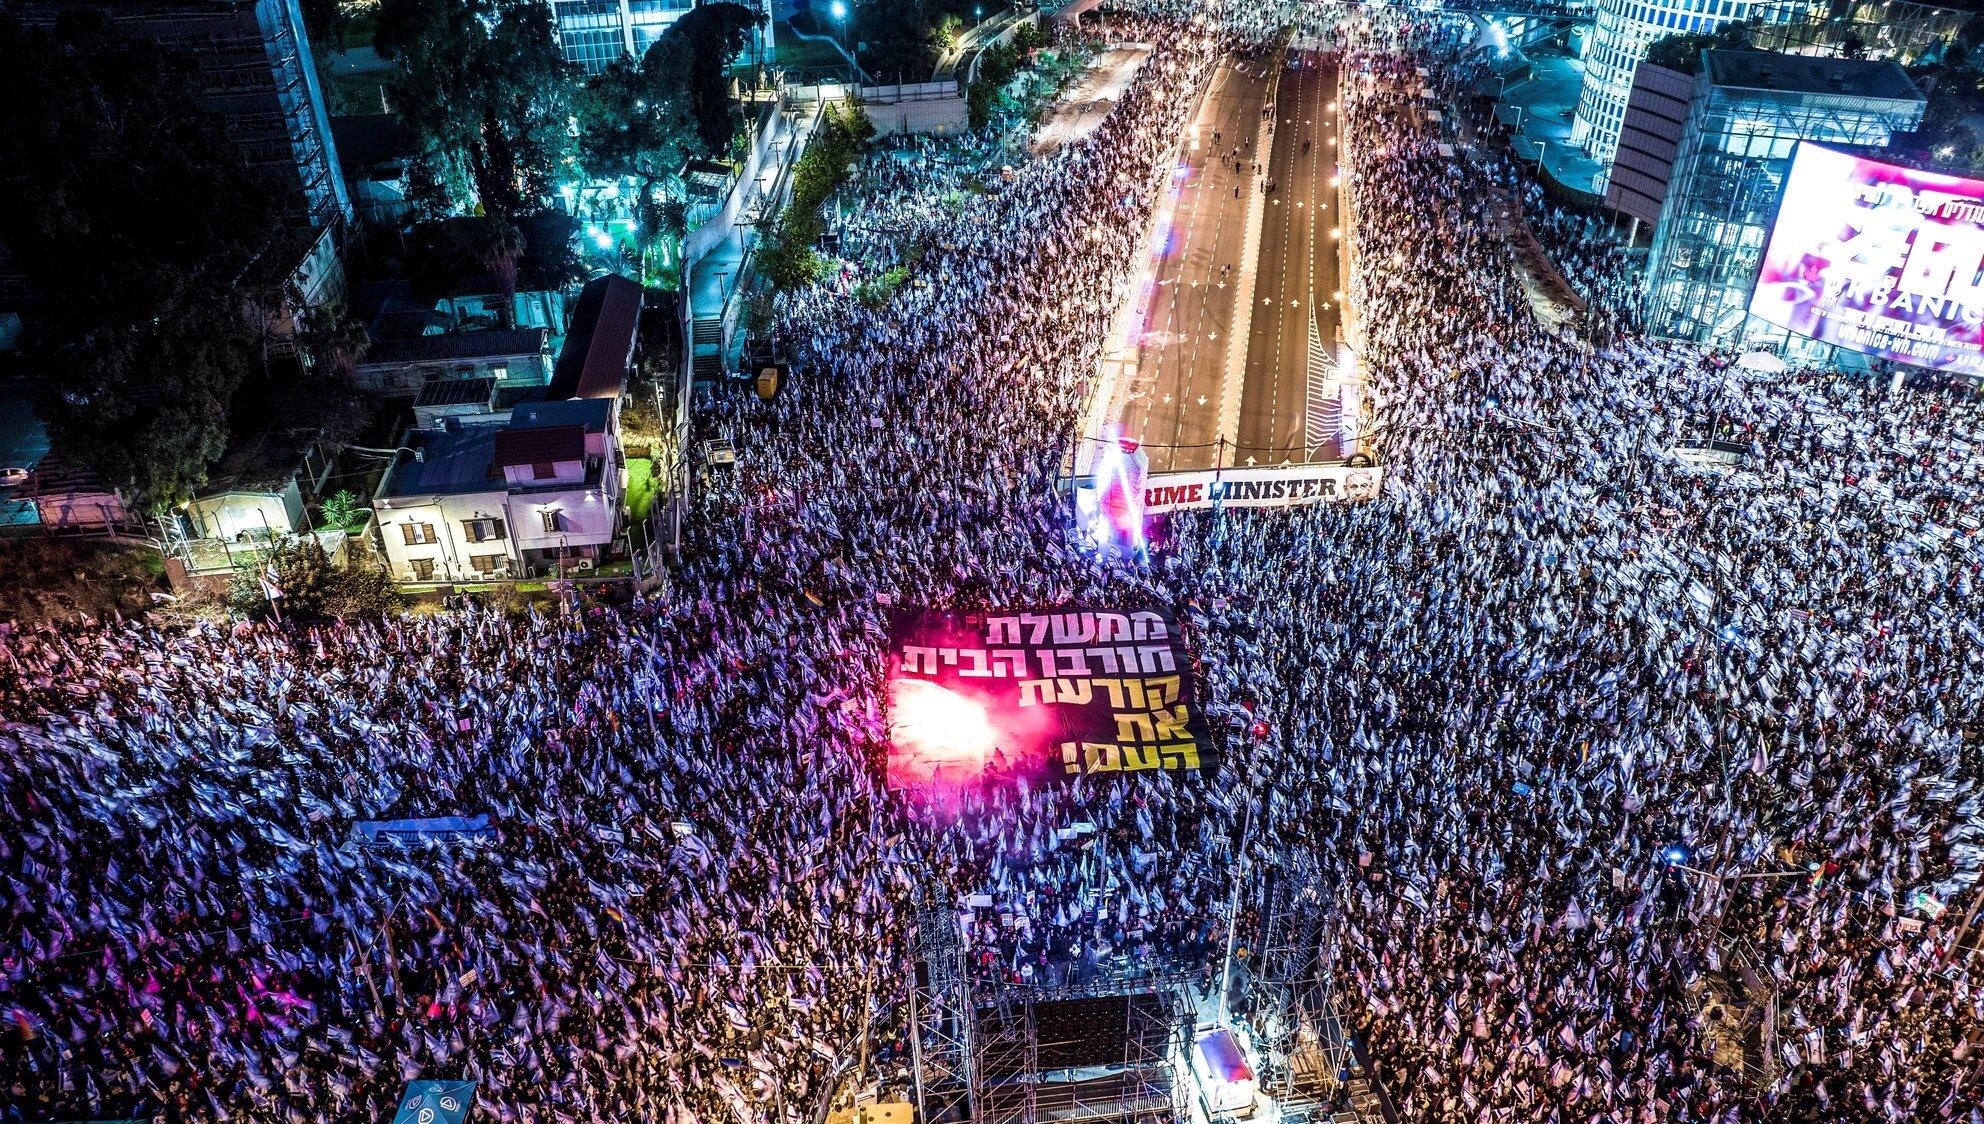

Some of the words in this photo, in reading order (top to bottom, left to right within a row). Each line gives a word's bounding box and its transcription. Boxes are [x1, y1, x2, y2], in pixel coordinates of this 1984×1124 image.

[1144, 483, 1203, 507] RIME
[1208, 478, 1337, 501] MINISTER
[986, 611, 1169, 645] ממשלת
[901, 645, 1029, 678] הבית
[1036, 645, 1177, 678] חורבן
[1018, 675, 1181, 711] קורעת
[1113, 704, 1195, 742] את
[1061, 741, 1201, 775] העם!
